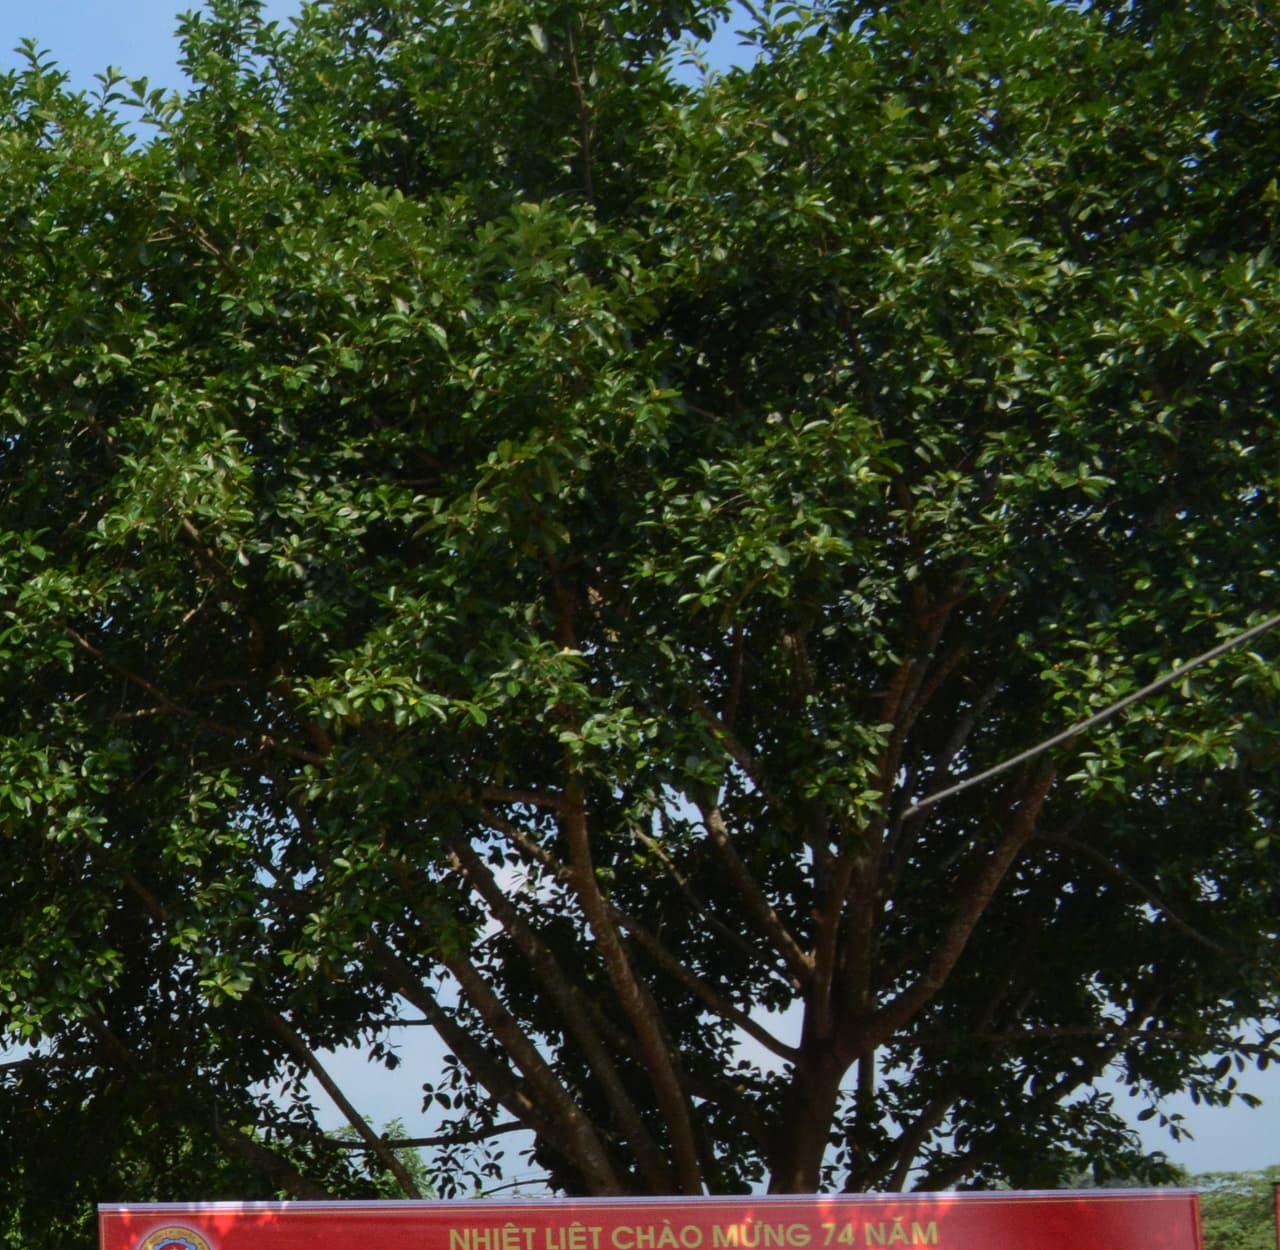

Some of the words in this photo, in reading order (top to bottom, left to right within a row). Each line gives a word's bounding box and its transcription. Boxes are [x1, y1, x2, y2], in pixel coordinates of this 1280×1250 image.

[611, 1219, 703, 1249] CHÀO
[712, 1217, 812, 1248] MỪNG
[821, 1223, 855, 1246] 74
[865, 1216, 938, 1246] NĂM
